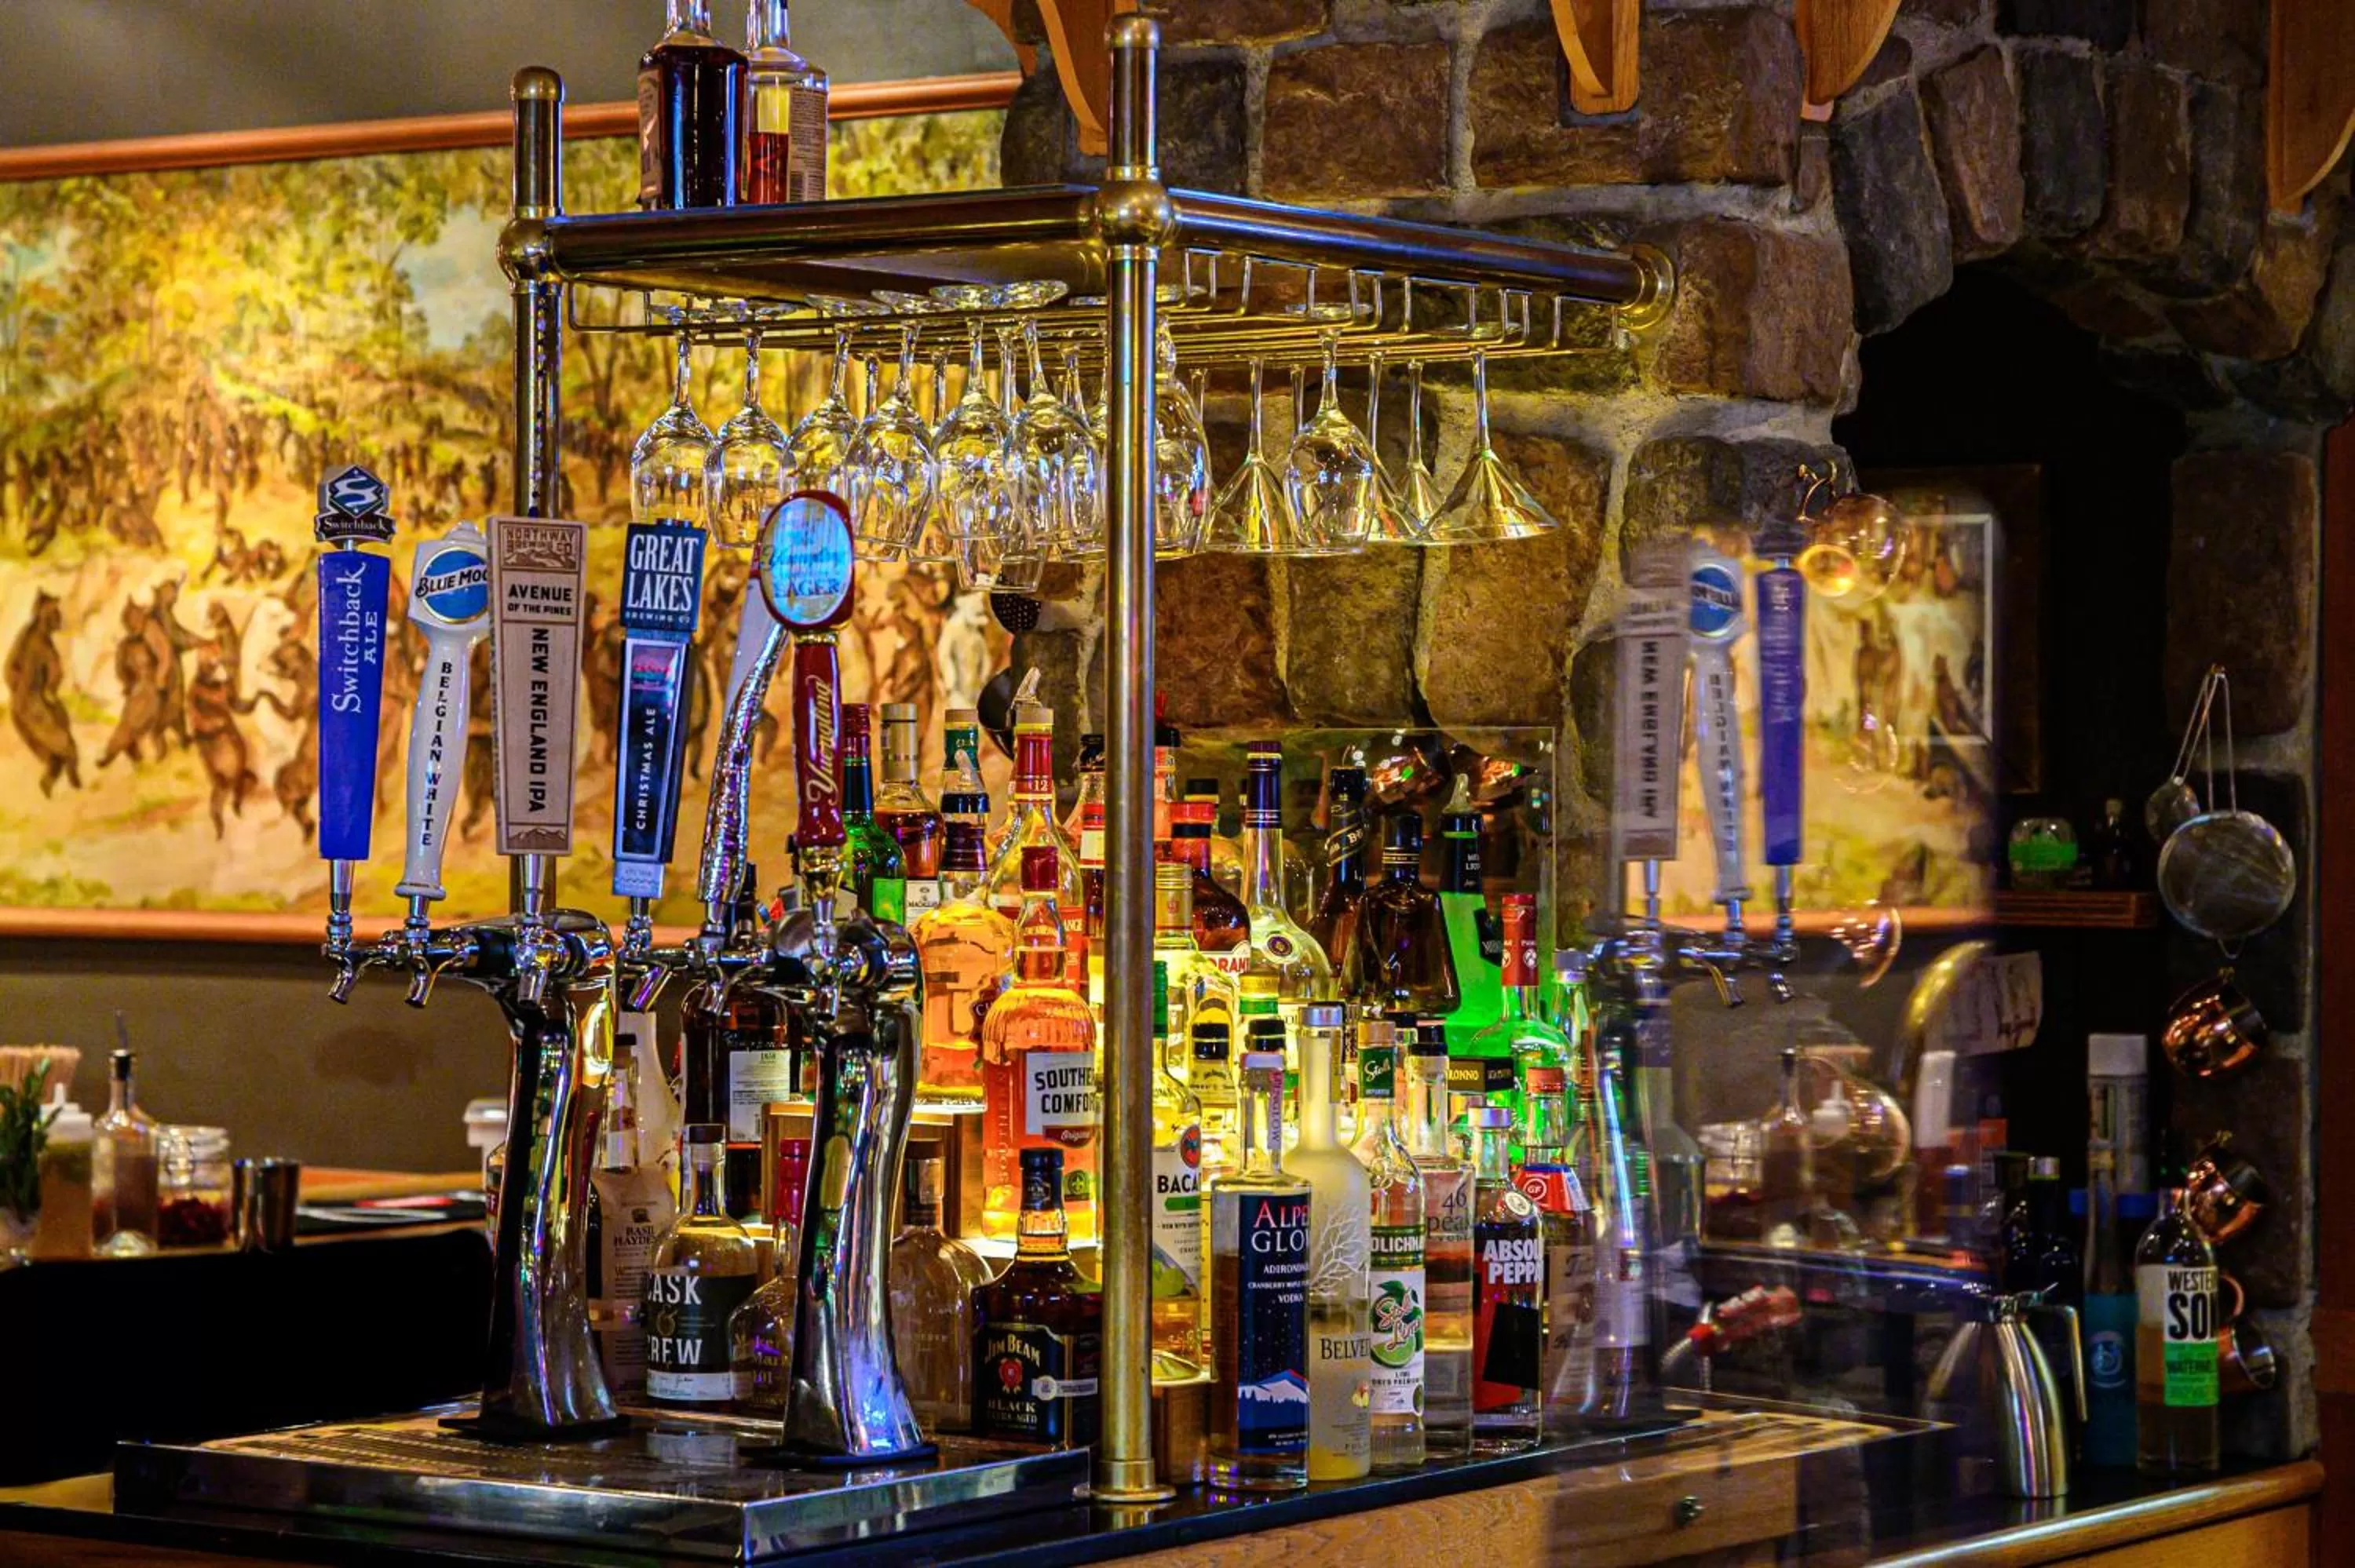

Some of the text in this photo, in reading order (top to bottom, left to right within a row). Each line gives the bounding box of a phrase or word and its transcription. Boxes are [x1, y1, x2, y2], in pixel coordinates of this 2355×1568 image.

[507, 527, 574, 541] NORTHWAY
[630, 534, 699, 574] GREAT
[415, 575, 455, 598] BLUE
[509, 584, 572, 602] AVENUE
[626, 573, 694, 612] LAKES
[507, 603, 572, 616] OF THE PINES
[331, 562, 366, 714] Switchback
[363, 611, 378, 665] ALE
[528, 628, 549, 813] NEW ENGLAND IPA
[422, 662, 453, 846] BELGIAN WHITE
[635, 708, 656, 830] CHRISTMAS ALE
[1157, 1174, 1201, 1194] BACA
[984, 1333, 1041, 1368] JIM BEAM
[987, 1398, 1037, 1413] BLACK
